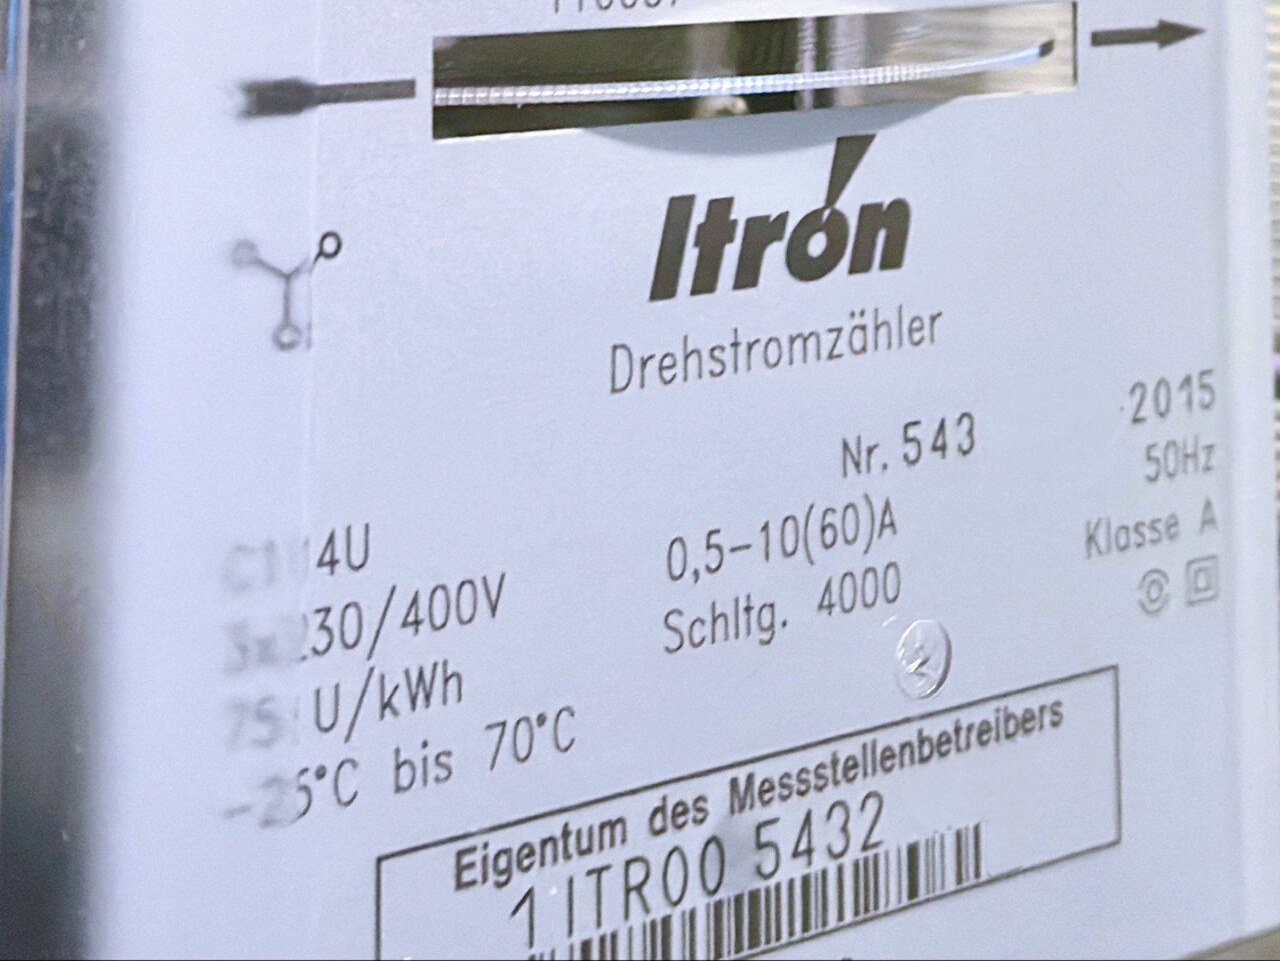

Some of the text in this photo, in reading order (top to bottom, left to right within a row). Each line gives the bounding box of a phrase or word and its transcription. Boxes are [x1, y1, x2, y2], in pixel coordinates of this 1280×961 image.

[649, 194, 911, 301] Itron
[609, 305, 943, 394] Drehstromzähler
[1128, 368, 1216, 425] 2015
[841, 412, 976, 477] Nr. 543
[1145, 435, 1215, 482] 50Hz
[1084, 496, 1218, 559] Klasse A
[663, 562, 901, 654] Schltg. 4000
[394, 742, 452, 795] bis
[484, 706, 576, 771] 70°C
[453, 695, 1064, 892] Eigentum des Messstellenbetreibers
[754, 790, 883, 880] 5432
